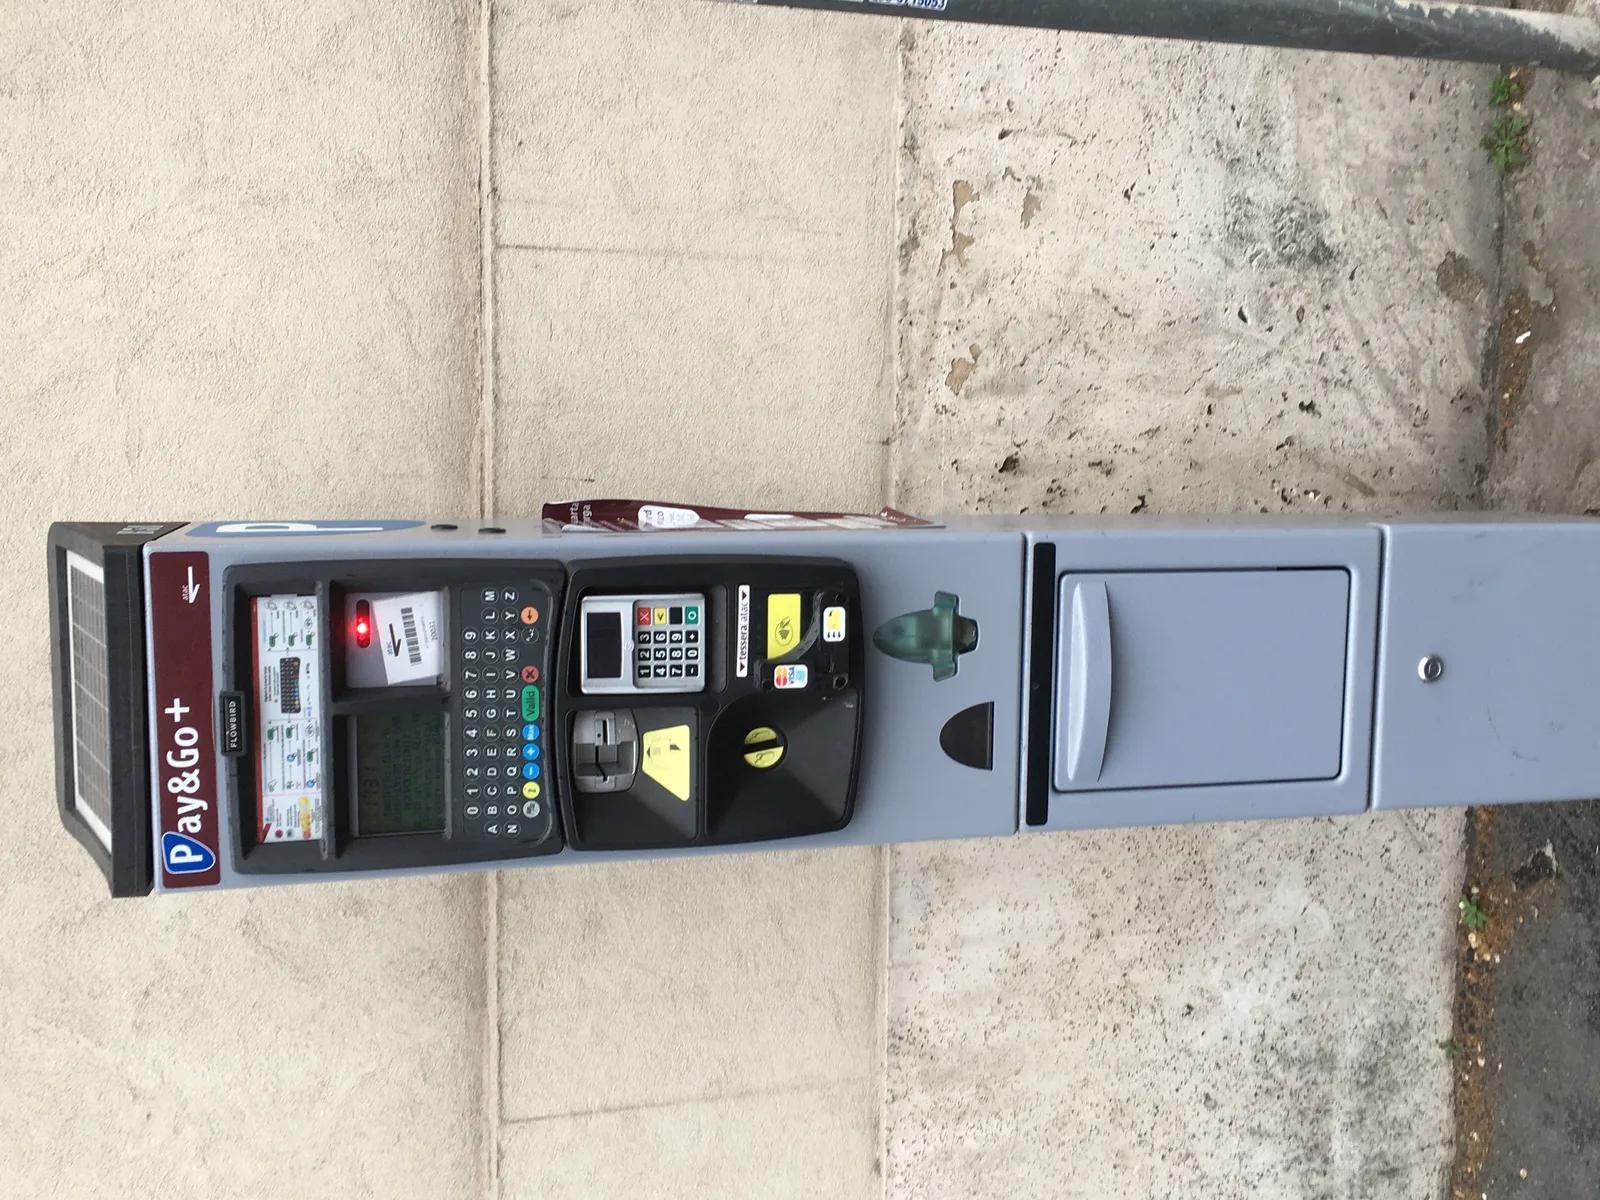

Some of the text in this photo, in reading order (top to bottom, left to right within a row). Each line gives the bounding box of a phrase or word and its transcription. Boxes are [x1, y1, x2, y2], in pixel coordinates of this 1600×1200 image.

[486, 592, 494, 600] M
[486, 631, 495, 639] K
[506, 631, 515, 639] X
[738, 602, 749, 660] tessera atac
[506, 650, 515, 660] W
[656, 668, 666, 676] 4
[487, 690, 495, 698] H
[506, 690, 515, 698] U
[526, 690, 535, 717] Valid
[487, 709, 496, 718] G
[228, 701, 238, 748] FLOWBIRD
[466, 729, 477, 737] 4
[487, 748, 496, 756] E
[507, 748, 516, 756] R
[507, 767, 516, 776] Q
[488, 787, 497, 795] C
[488, 806, 497, 814] B
[508, 806, 516, 814] O
[488, 825, 497, 833] A
